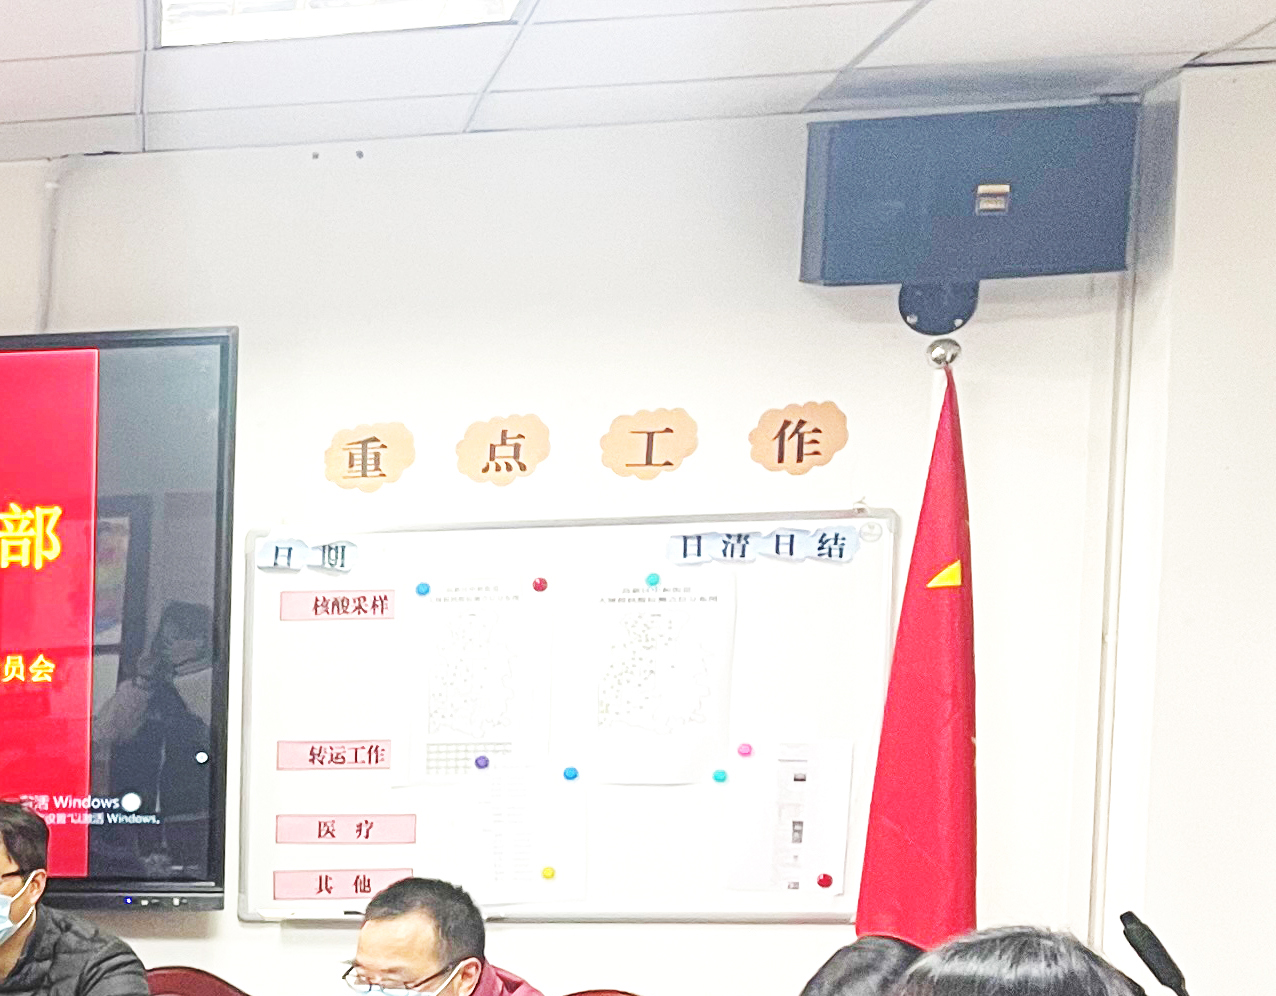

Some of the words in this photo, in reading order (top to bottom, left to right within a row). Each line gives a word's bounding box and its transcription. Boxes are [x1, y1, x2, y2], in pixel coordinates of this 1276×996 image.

[340, 418, 824, 480] 重点工作
[682, 532, 847, 560] 日清日结
[312, 594, 390, 616] 核酸采样
[308, 744, 386, 766] 转运工作
[52, 794, 121, 810] Windows
[316, 818, 375, 840] 医疗
[315, 874, 373, 895] 其他
